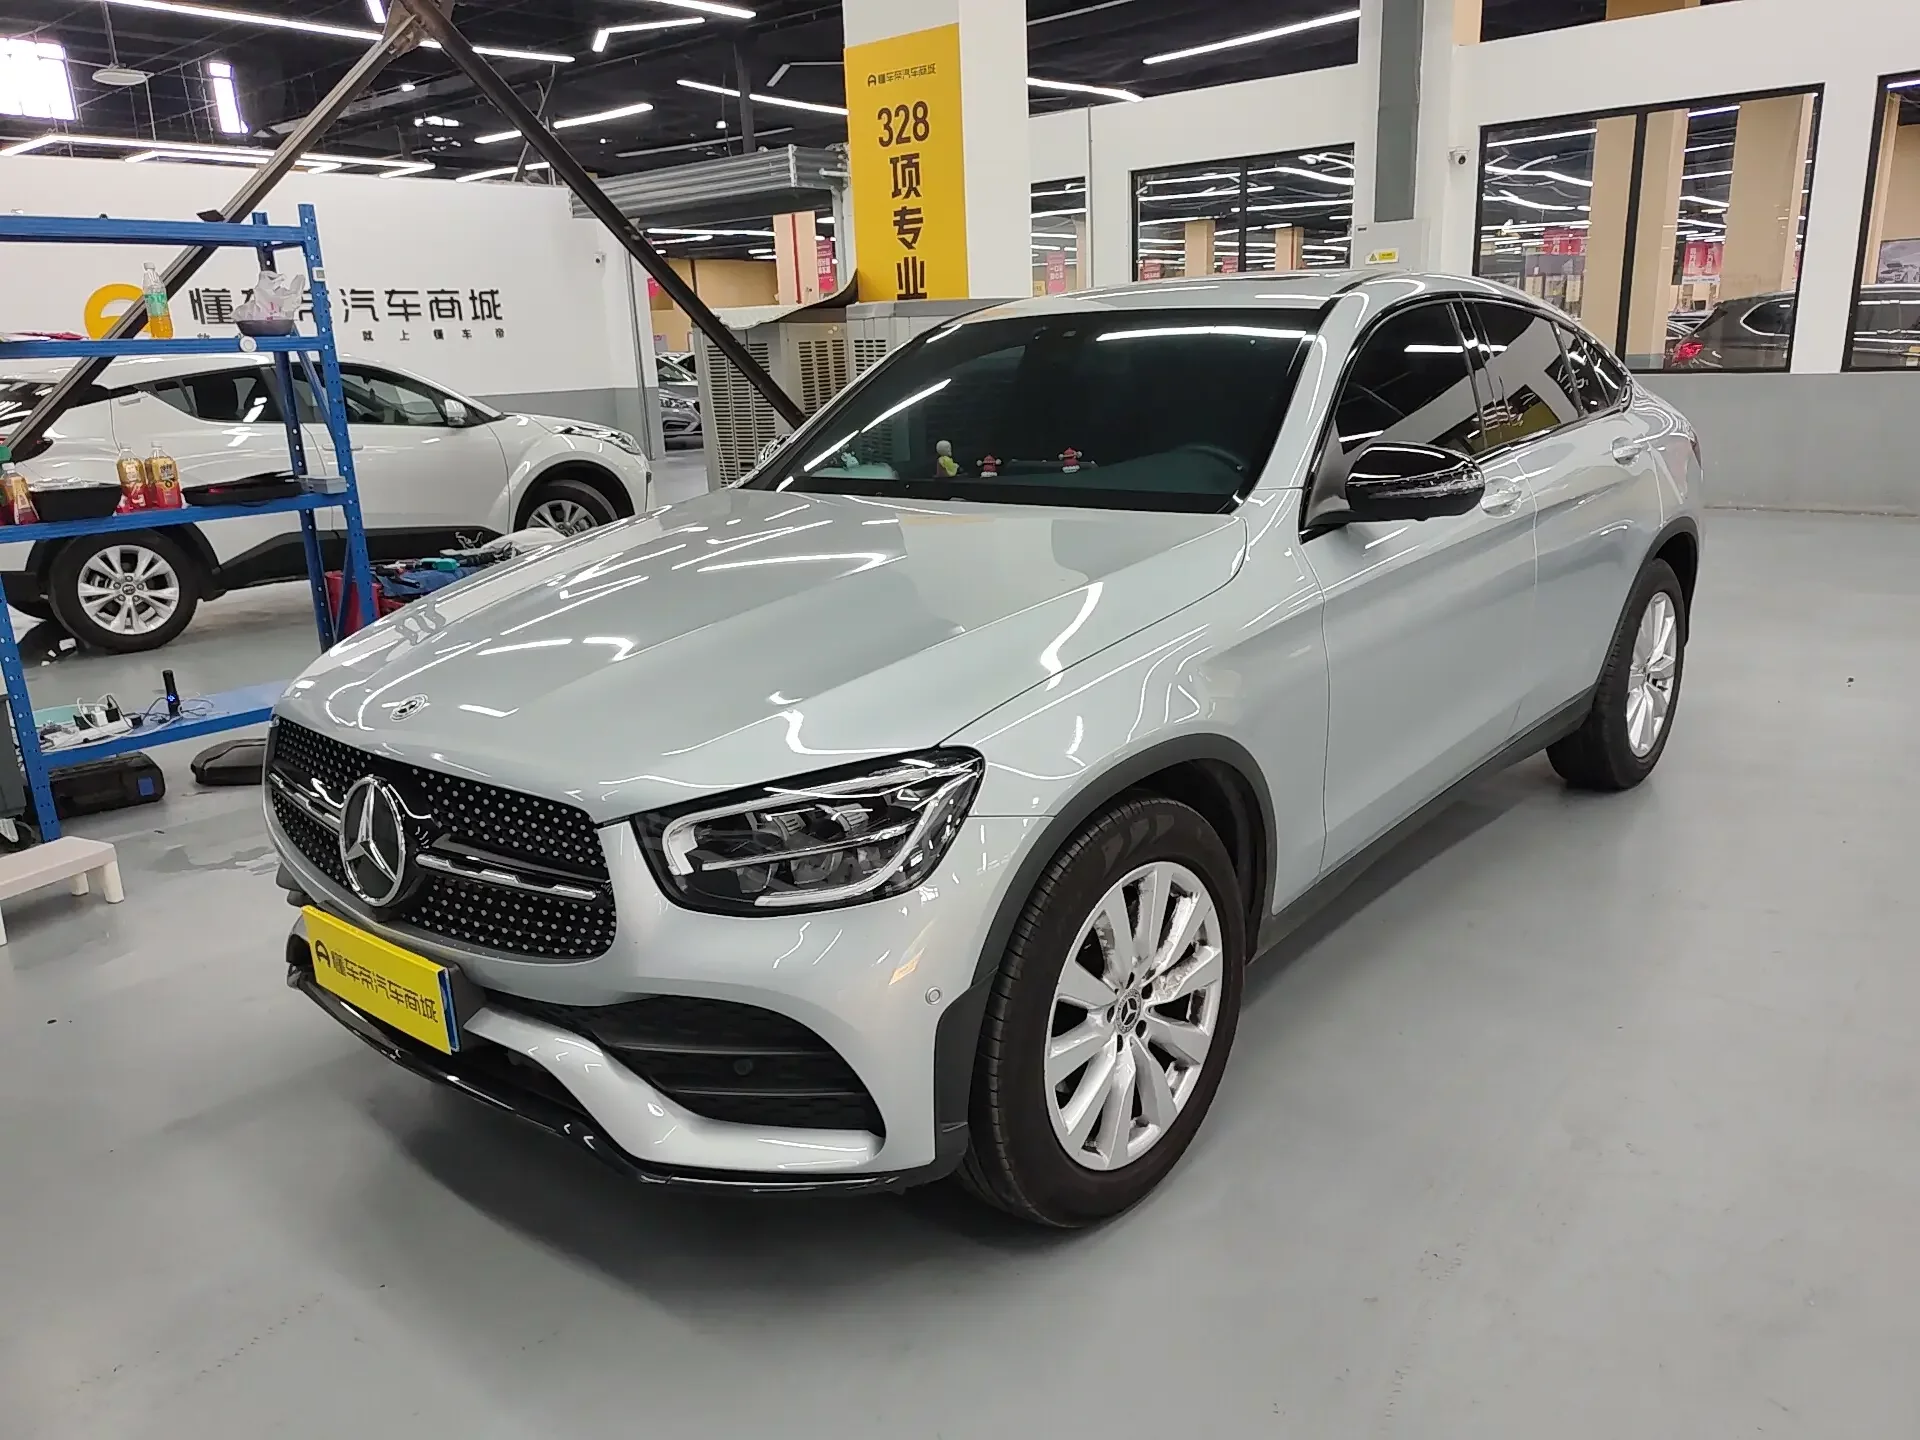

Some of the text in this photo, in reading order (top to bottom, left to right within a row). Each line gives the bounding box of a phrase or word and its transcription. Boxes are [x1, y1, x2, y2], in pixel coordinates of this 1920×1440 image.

[877, 101, 930, 148] 328
[189, 288, 502, 325] 懂汽车商城
